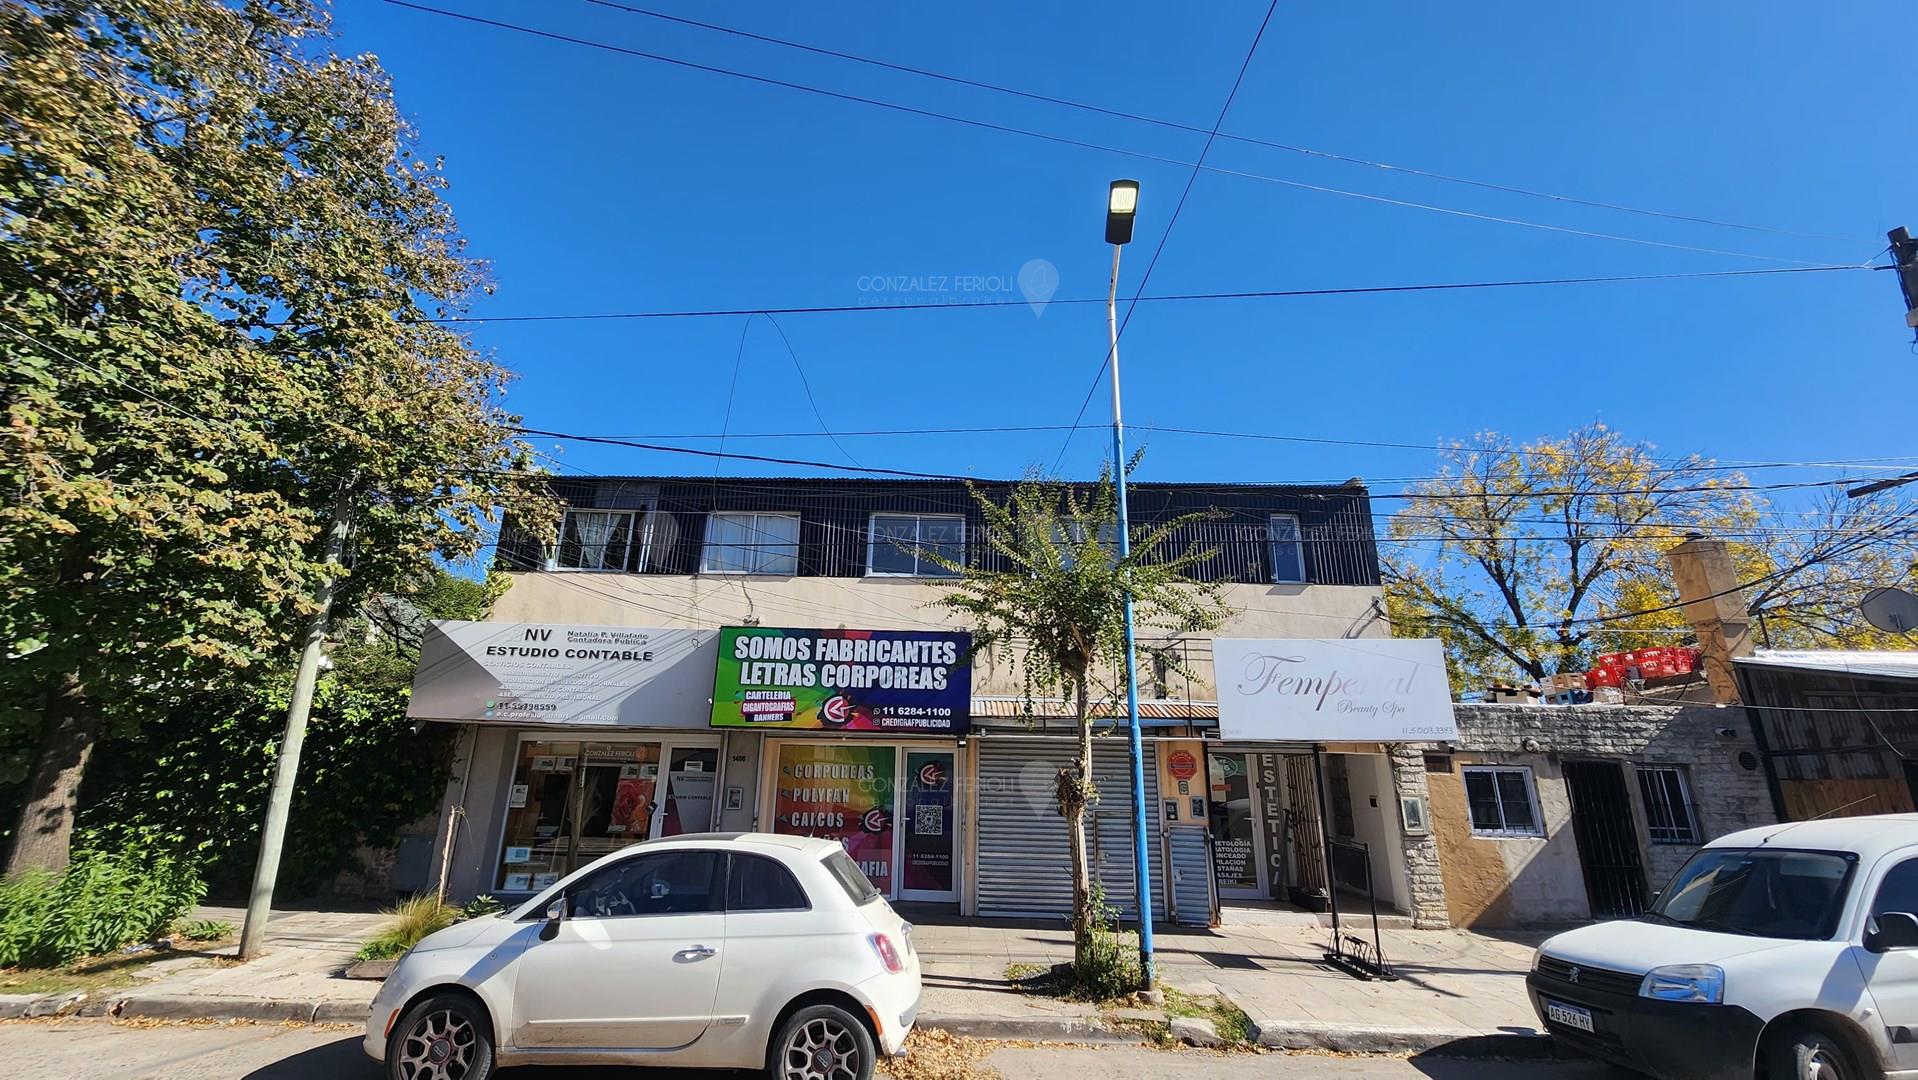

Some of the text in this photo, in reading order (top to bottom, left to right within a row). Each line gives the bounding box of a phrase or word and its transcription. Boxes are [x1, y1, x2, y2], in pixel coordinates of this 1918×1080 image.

[525, 629, 552, 642] NV
[567, 636, 612, 644] Contadora
[486, 646, 654, 662] ESTUDIO CONTABLE
[735, 636, 957, 665] SOMOS FABRICANTES
[740, 662, 948, 691] LETRAS CORPOREAS
[745, 690, 792, 700] CARTELERIA
[742, 701, 795, 712] GIGANTOGRAFIAS
[883, 706, 951, 717] 11 6284-1100
[1337, 699, 1406, 718] Beauty Spa
[753, 713, 784, 722] BANNERS
[882, 717, 951, 728] CREDIGRAFPUBLICIDAD
[794, 763, 875, 780] CORPOREAS
[793, 787, 850, 803] POLYFAN
[1551, 1007, 1561, 1020] AG
[1561, 1010, 1578, 1026] 526
